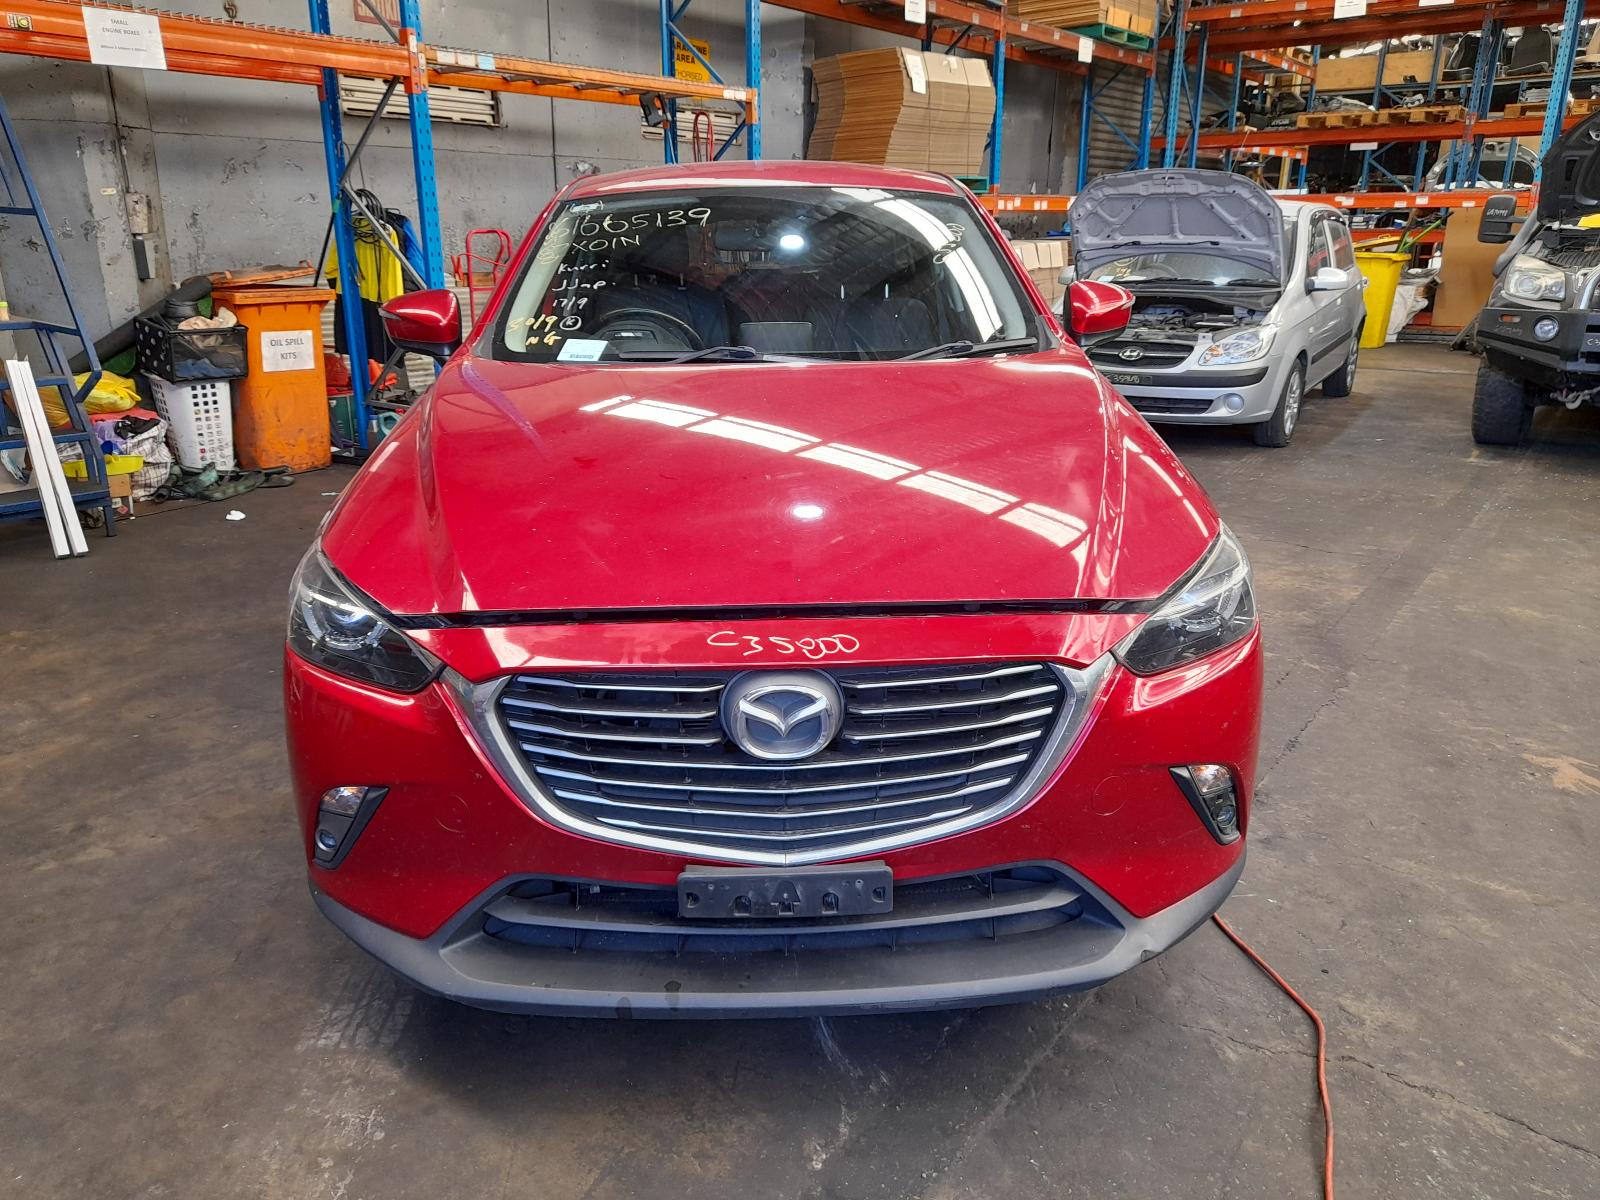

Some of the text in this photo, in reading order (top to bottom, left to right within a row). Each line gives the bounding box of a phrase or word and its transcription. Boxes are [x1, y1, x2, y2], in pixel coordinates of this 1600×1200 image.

[676, 54, 695, 64] AREA
[270, 338, 304, 347] OIL SPILL
[280, 351, 297, 360] KITS
